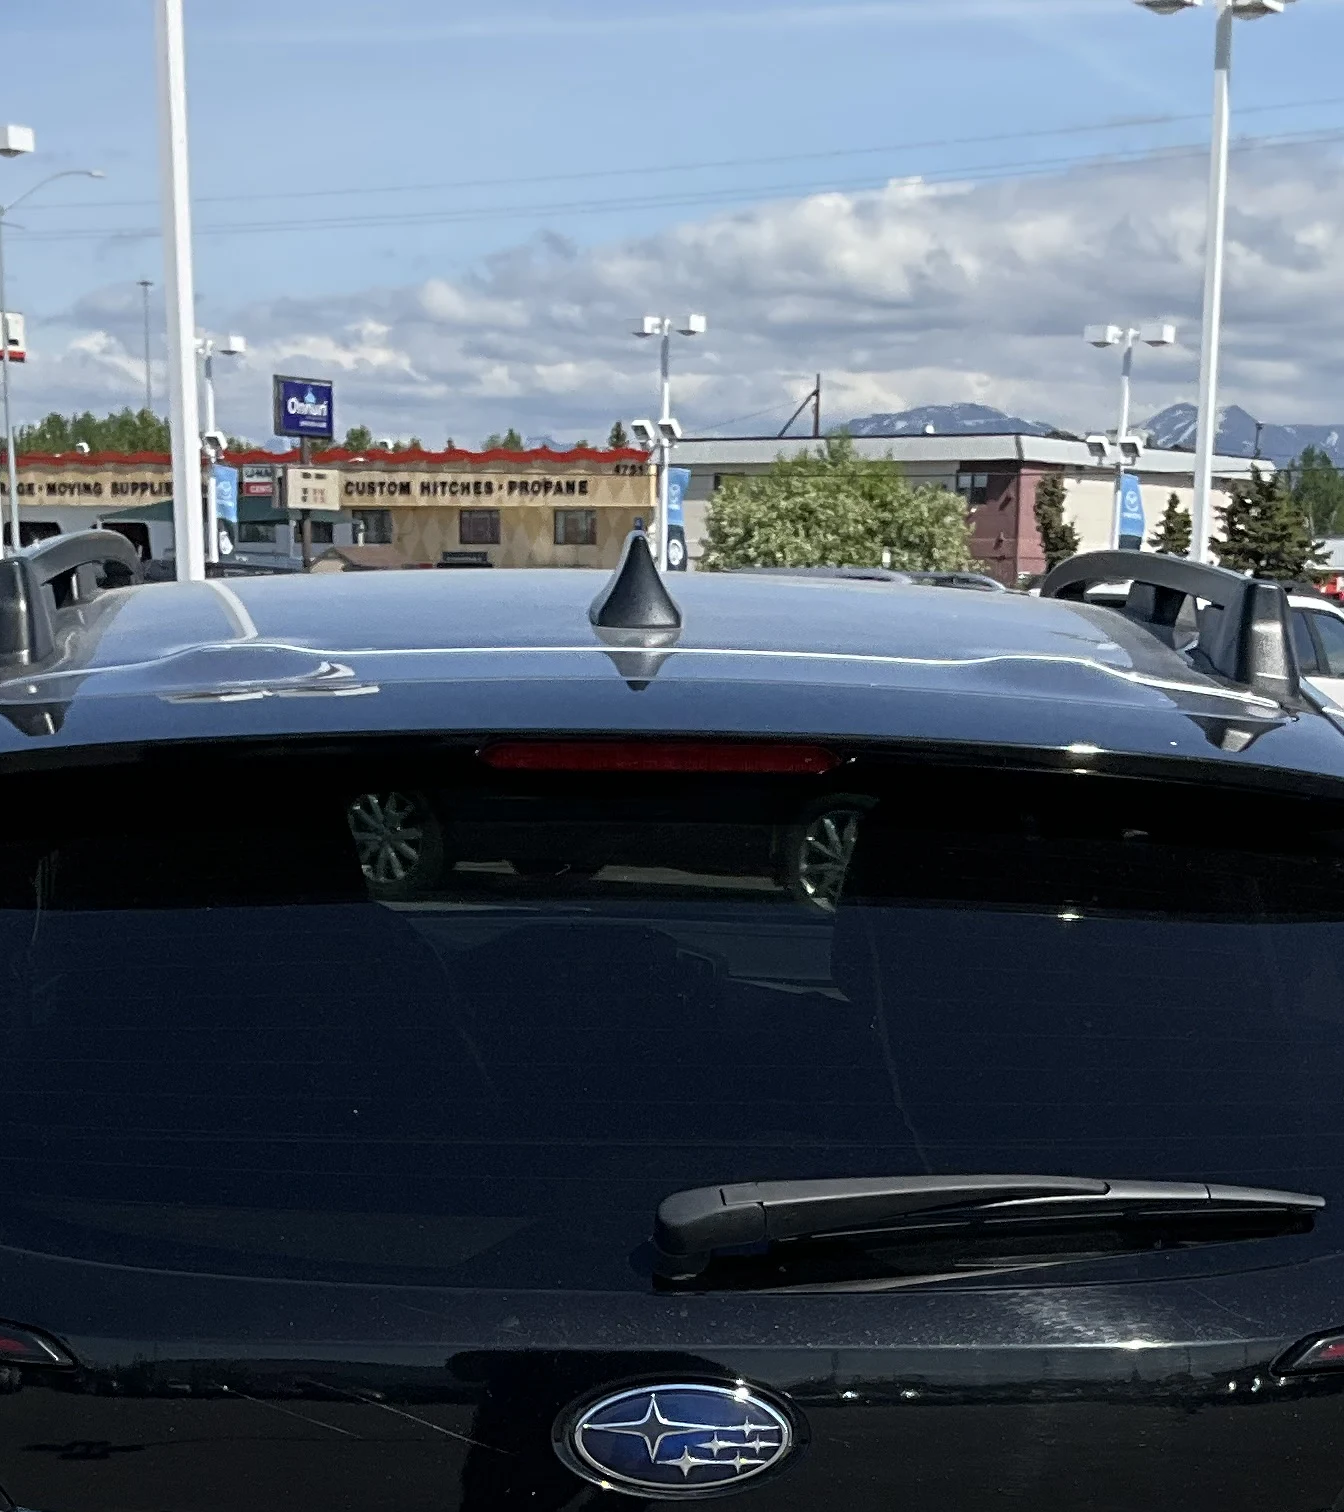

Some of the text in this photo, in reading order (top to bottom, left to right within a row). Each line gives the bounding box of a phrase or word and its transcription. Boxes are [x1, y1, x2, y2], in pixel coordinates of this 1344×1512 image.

[46, 482, 102, 496] MOVING
[111, 481, 174, 496] SUPPLIE
[344, 480, 588, 496] CUSTOM HITCHES PROPANE
